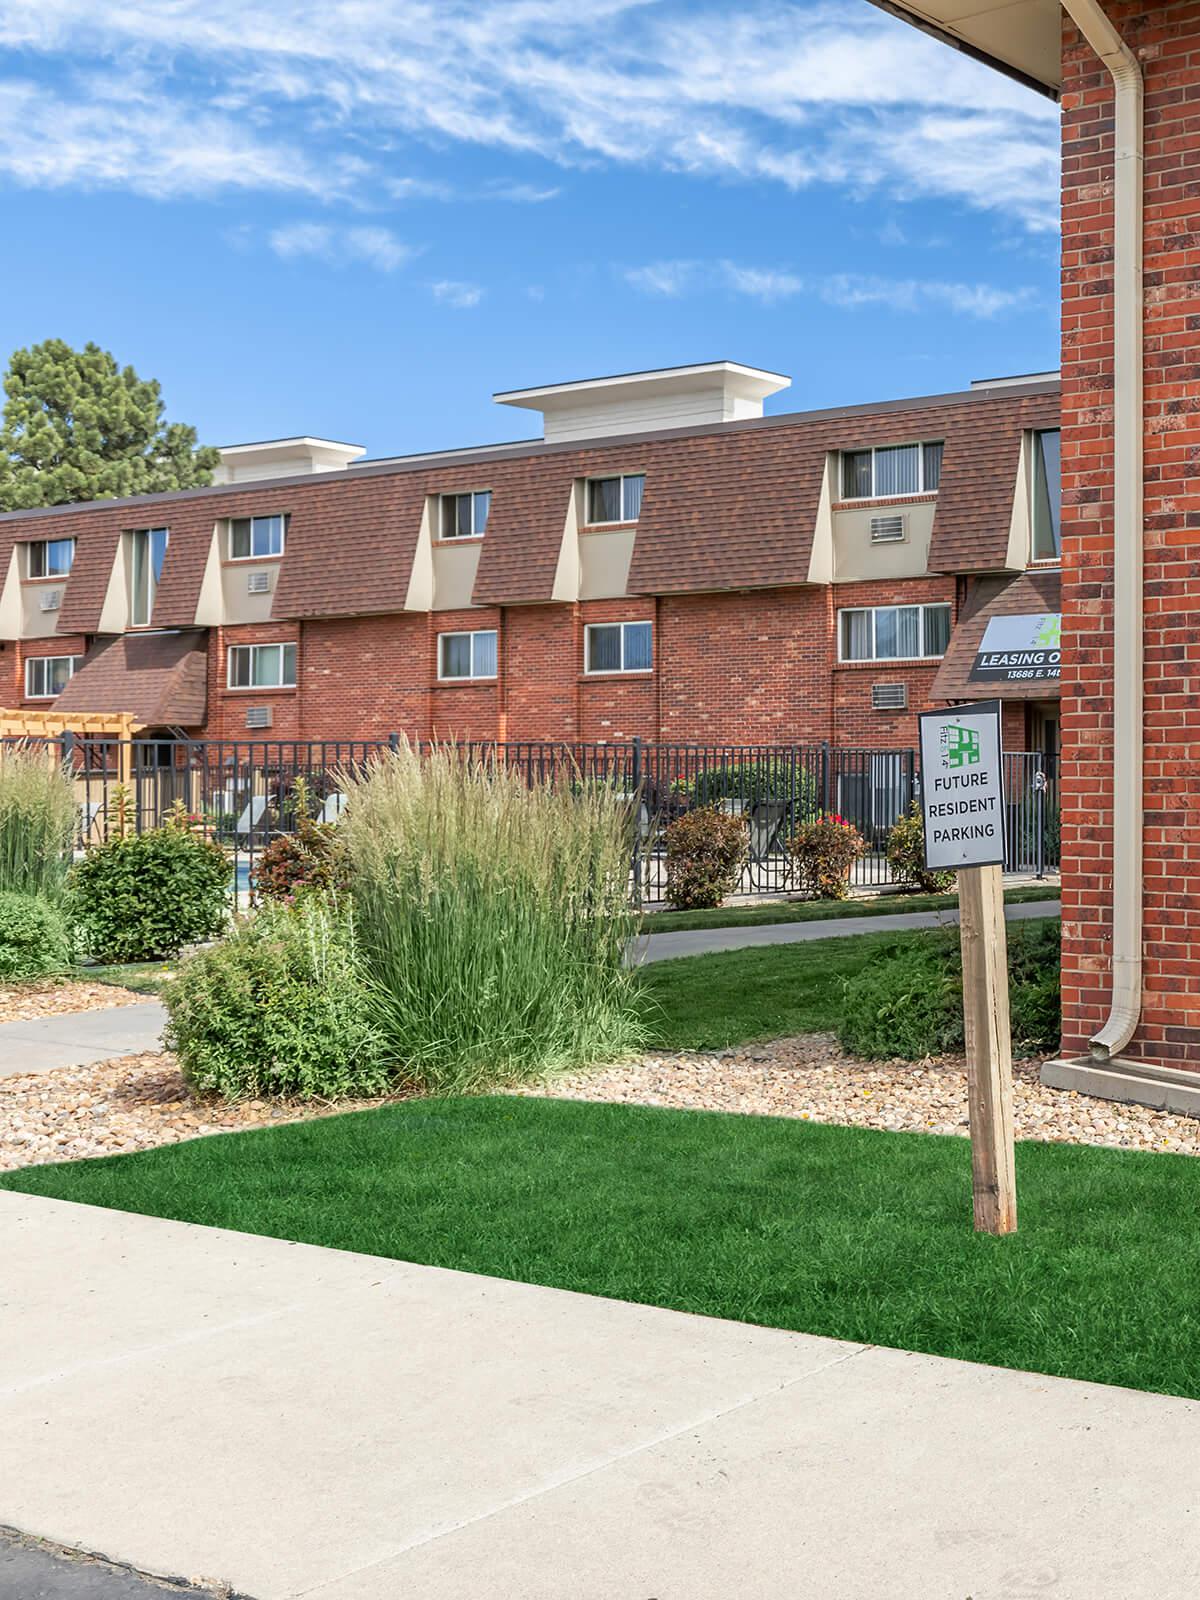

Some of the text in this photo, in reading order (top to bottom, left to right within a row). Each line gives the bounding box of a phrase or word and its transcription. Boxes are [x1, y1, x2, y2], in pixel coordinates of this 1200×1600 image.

[980, 652, 1045, 666] LEASING
[1007, 670, 1034, 679] 13686
[935, 772, 988, 791] FUTURE
[929, 797, 996, 818] RESIDENT
[934, 824, 995, 843] PARKING
